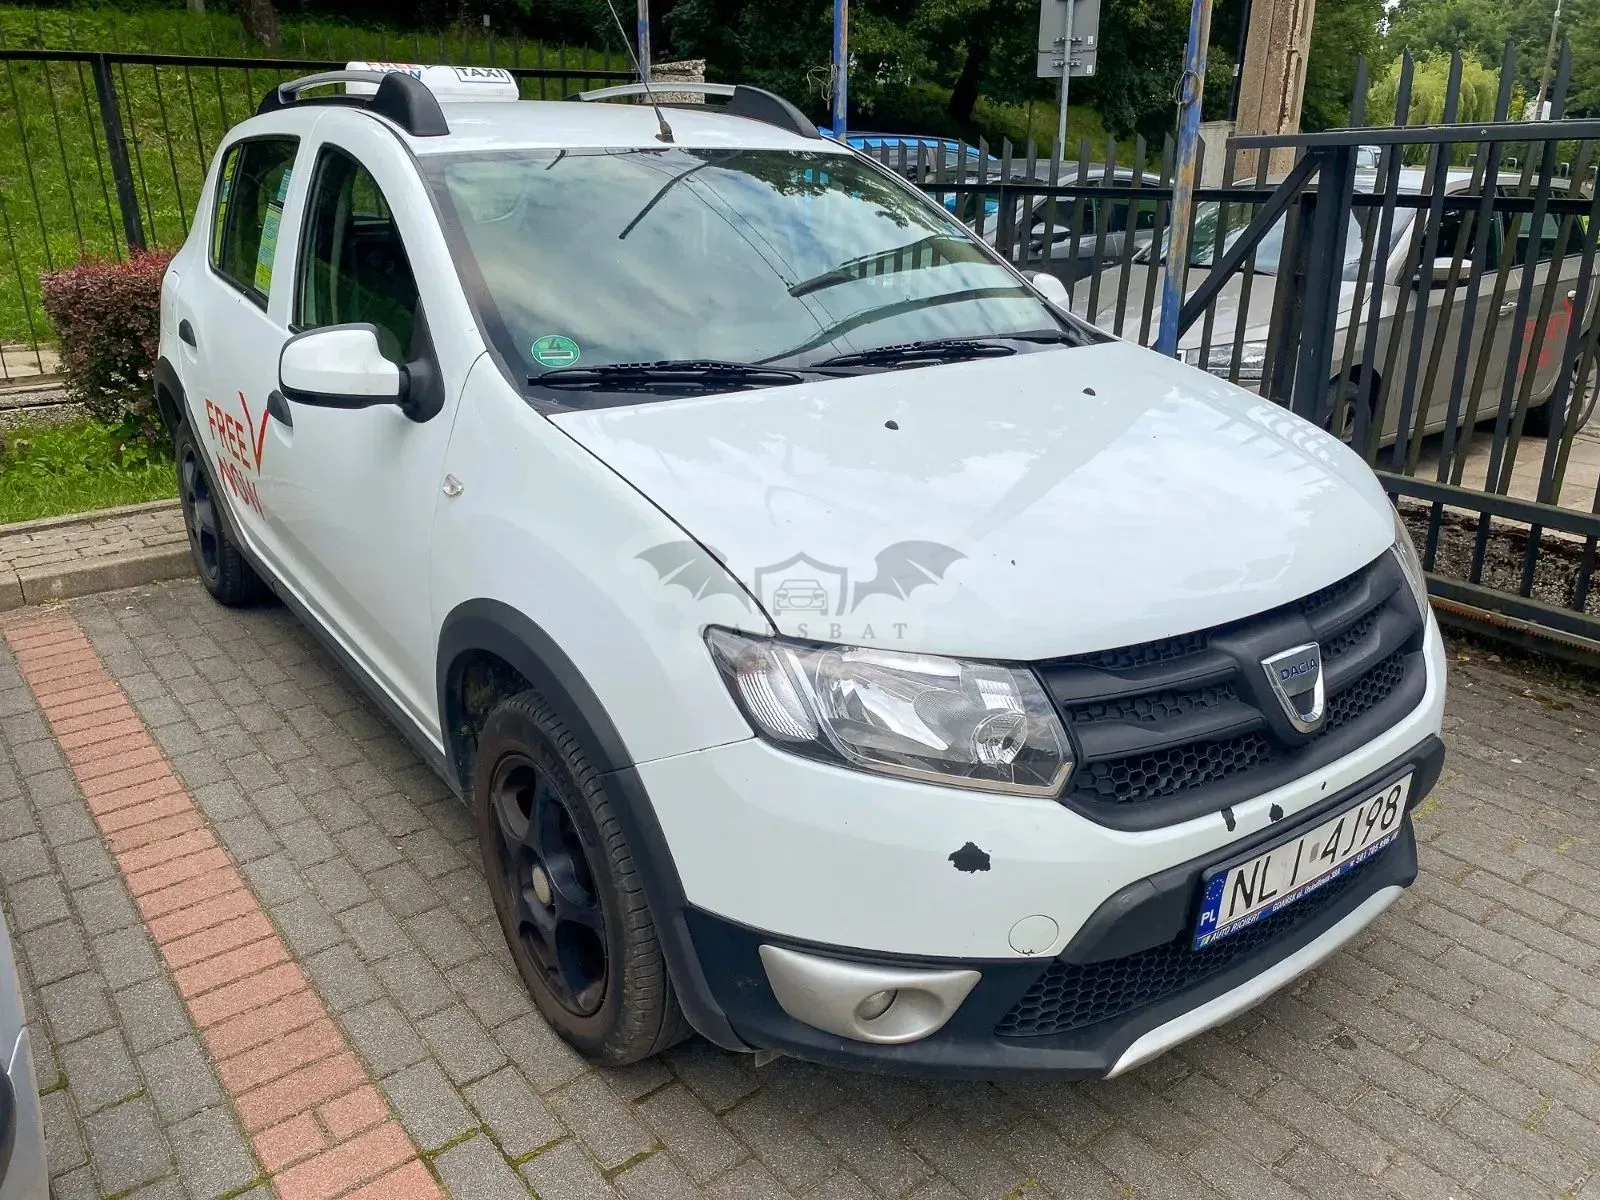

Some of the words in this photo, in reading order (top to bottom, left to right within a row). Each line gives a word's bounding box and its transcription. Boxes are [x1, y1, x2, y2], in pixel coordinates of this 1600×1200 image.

[455, 67, 505, 79] TAXI
[549, 336, 563, 351] 4
[205, 398, 251, 470] FREE
[216, 451, 265, 521] NOW
[1281, 659, 1317, 680] DACIA
[1200, 909, 1216, 926] PL
[1210, 926, 1231, 942] AUTO
[1231, 911, 1262, 933] RICHERT
